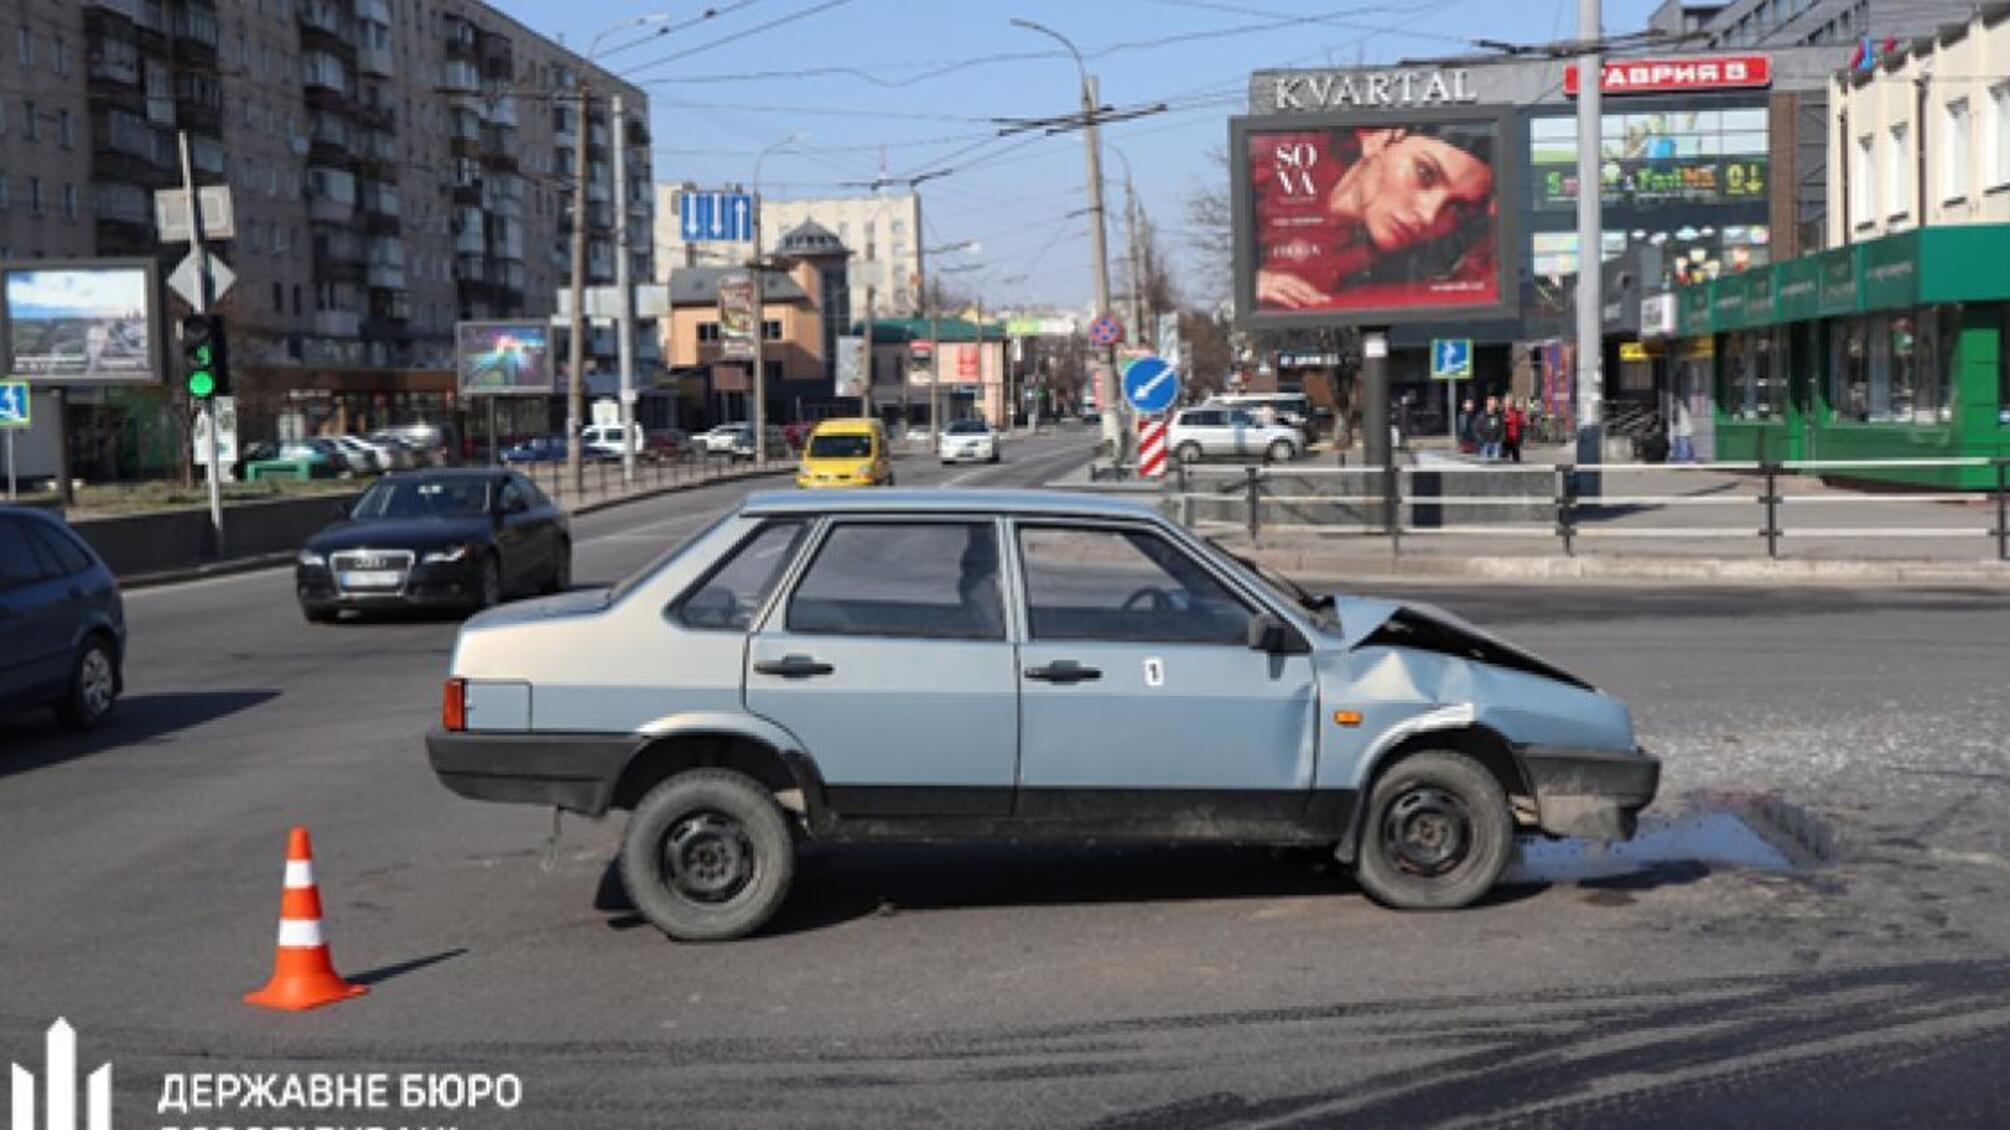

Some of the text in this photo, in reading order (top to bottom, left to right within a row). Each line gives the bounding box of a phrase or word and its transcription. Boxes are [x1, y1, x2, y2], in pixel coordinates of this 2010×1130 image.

[1601, 64, 1719, 86] АВРИЯ
[1275, 70, 1478, 109] KVARTAL
[1276, 143, 1317, 166] SO
[1276, 168, 1317, 195] VA
